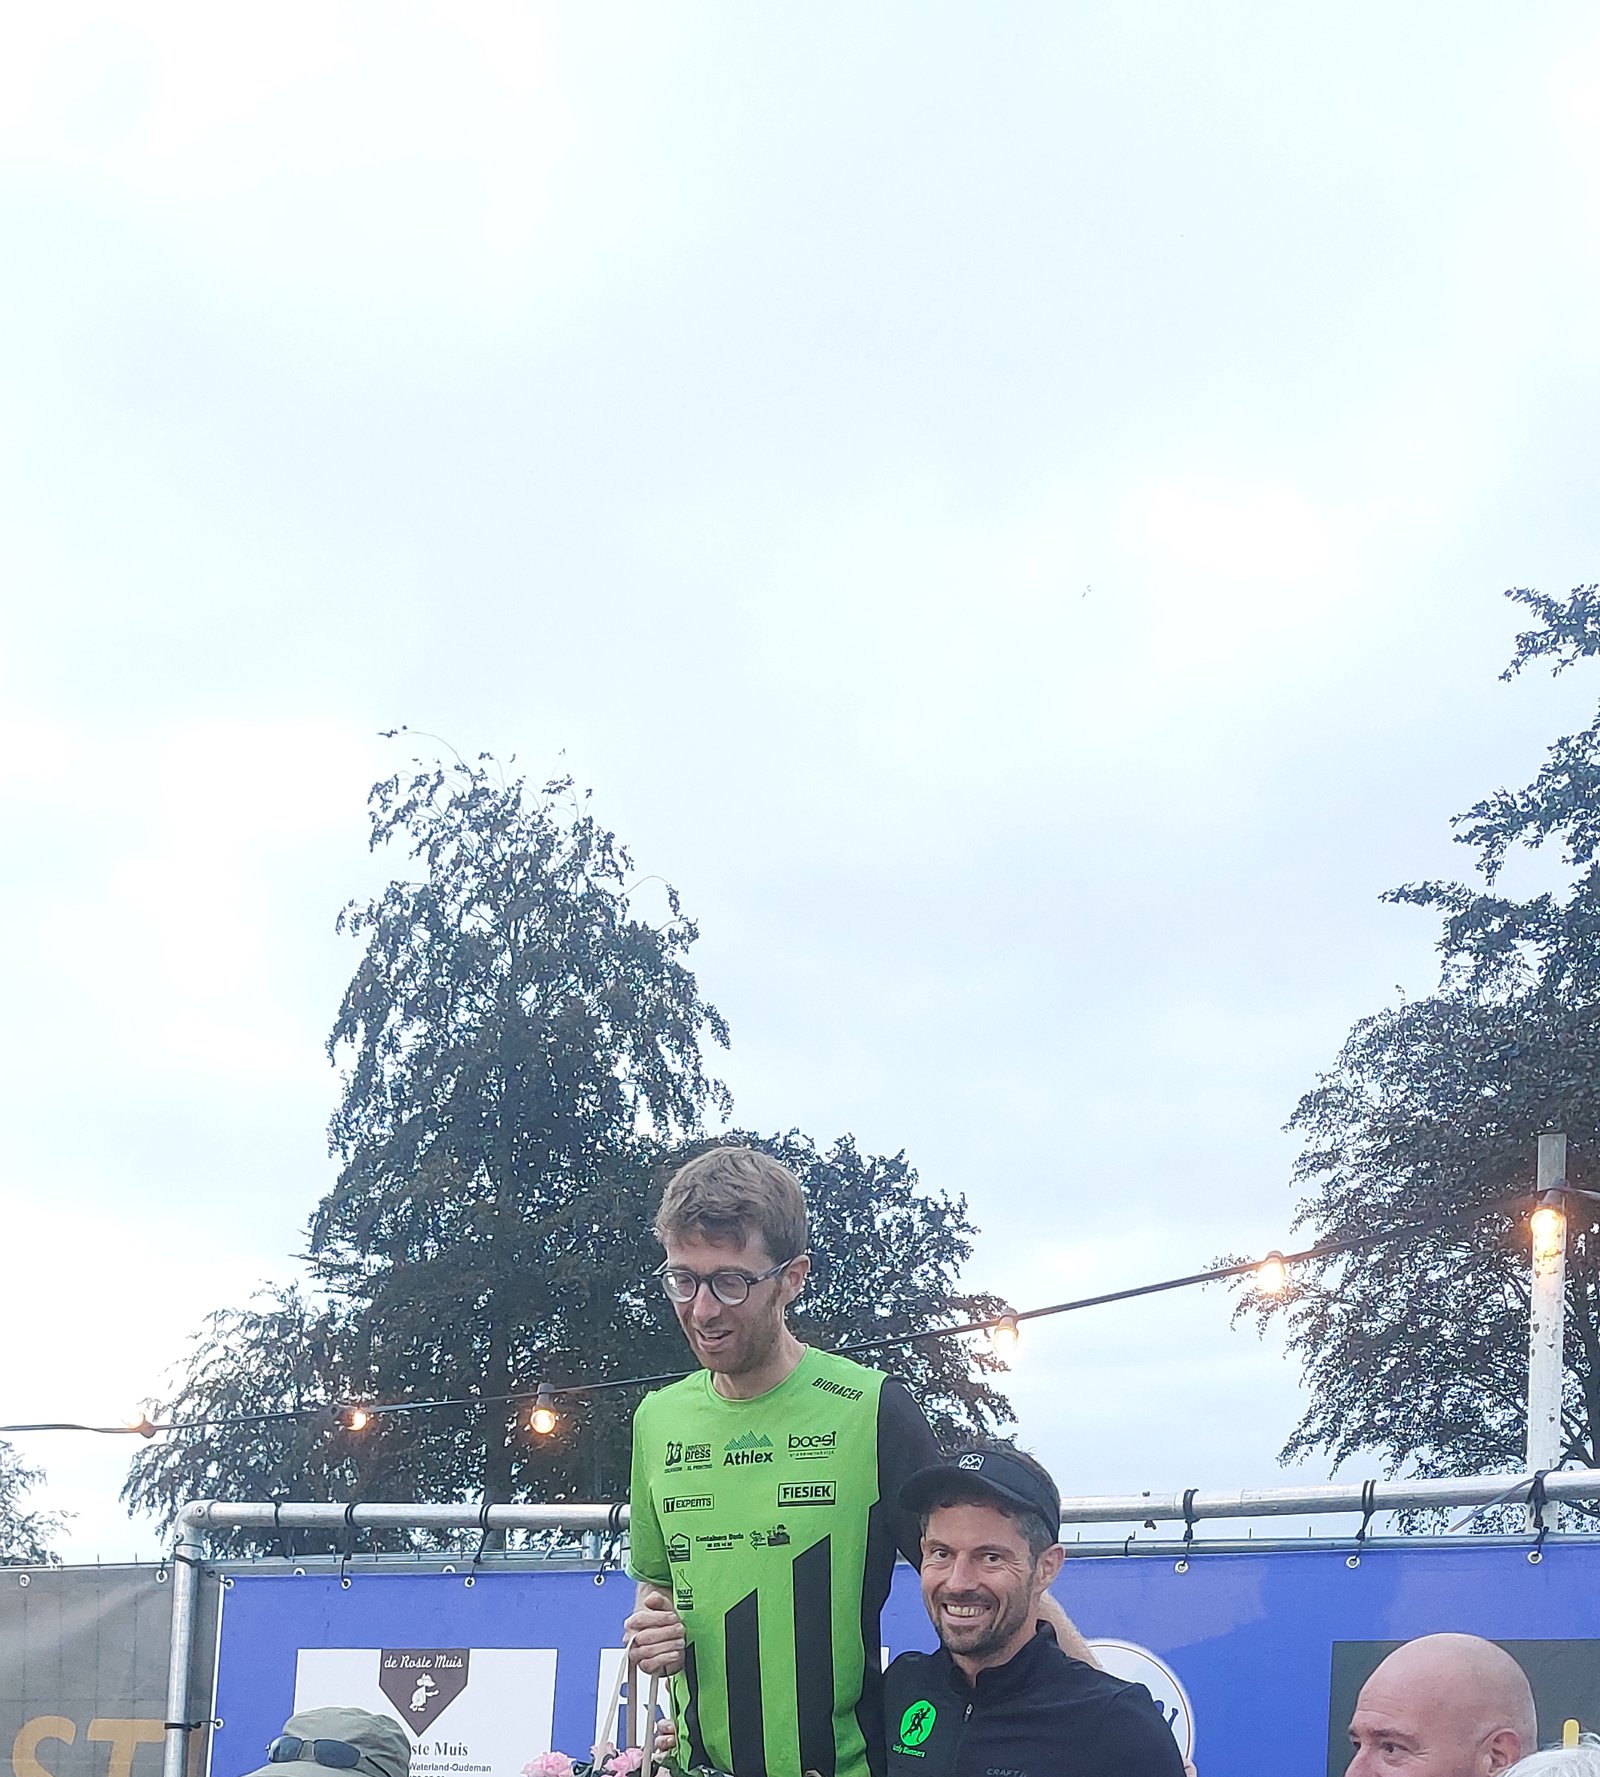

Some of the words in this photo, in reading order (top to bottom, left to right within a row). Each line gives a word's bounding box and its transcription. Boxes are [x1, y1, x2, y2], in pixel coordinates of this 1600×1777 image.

[812, 1377, 863, 1401] BIORACER
[723, 1450, 774, 1466] Athlex
[783, 1485, 831, 1499] FIESIEK
[384, 1656, 398, 1668] de
[400, 1655, 433, 1668] Roste
[434, 1655, 463, 1668] Muis
[411, 1743, 430, 1756] ste
[434, 1742, 469, 1756] Muis
[409, 1763, 492, 1772] Waterland-Oudeman
[986, 1768, 1019, 1776] CRAFT
